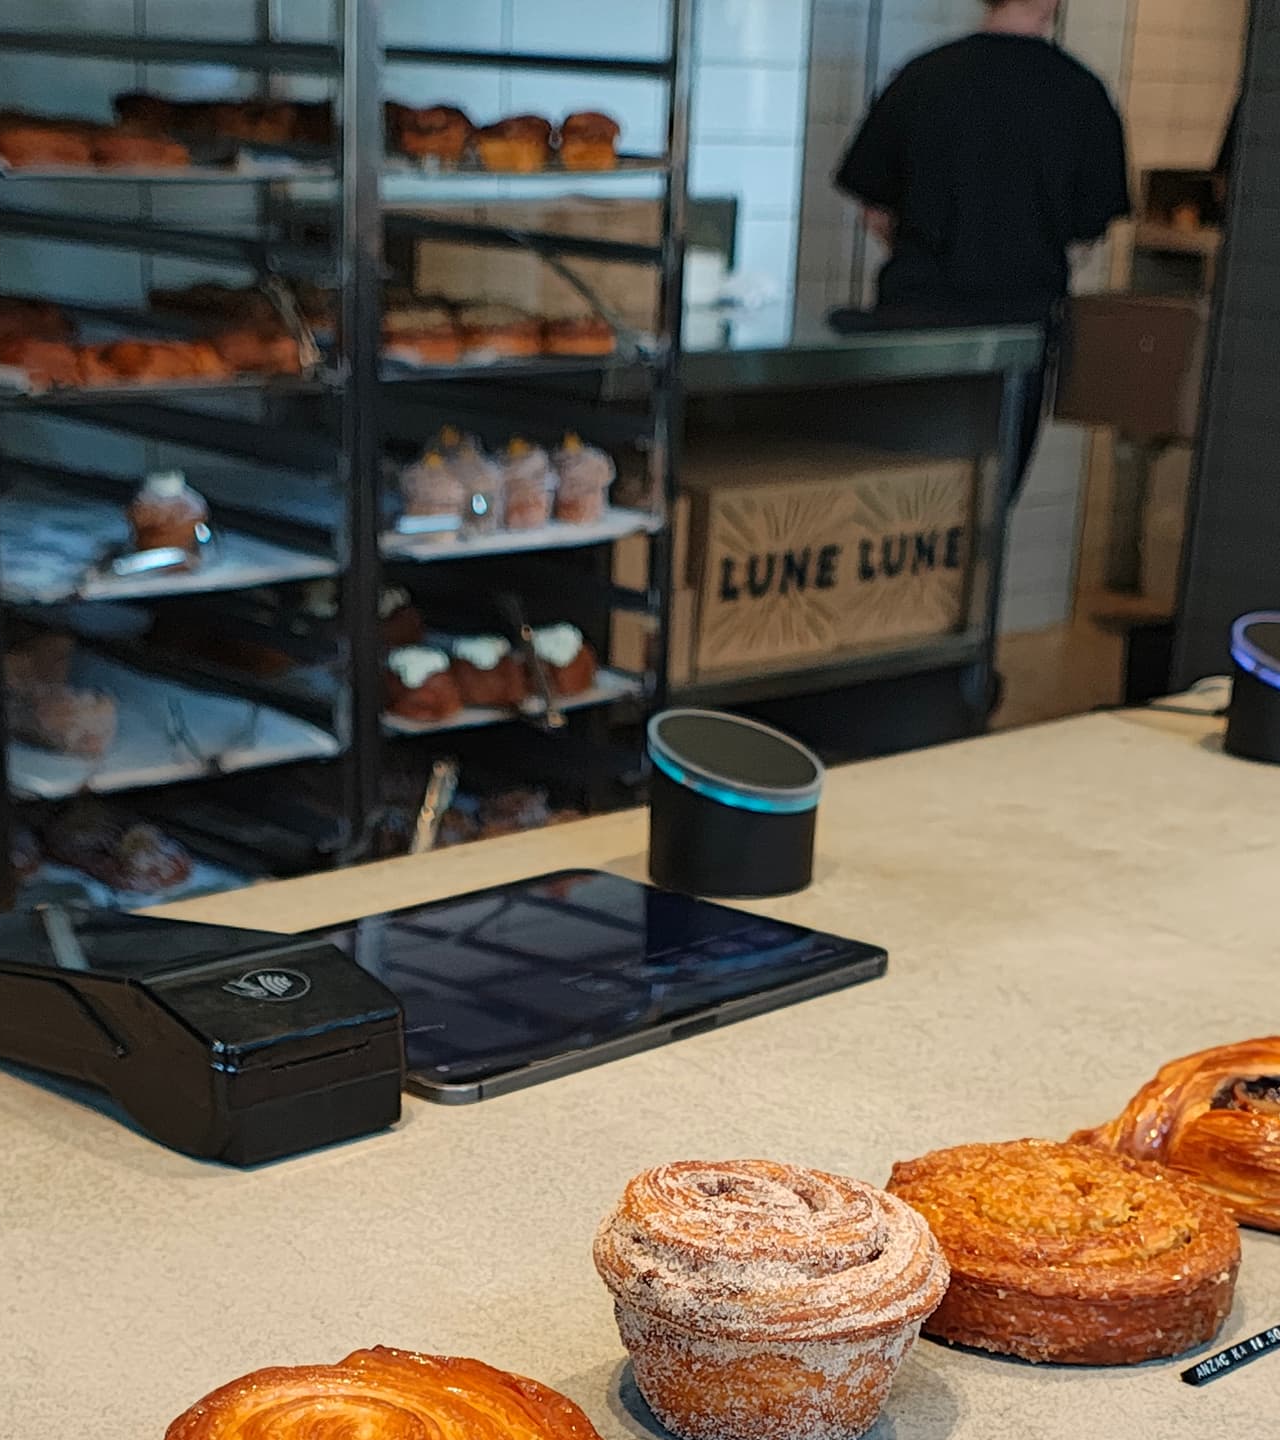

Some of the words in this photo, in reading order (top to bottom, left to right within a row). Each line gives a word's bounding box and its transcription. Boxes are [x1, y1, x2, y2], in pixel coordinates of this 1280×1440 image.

[720, 543, 842, 602] LUNE
[857, 526, 964, 582] LUNE
[1195, 1353, 1230, 1379] ANZAC
